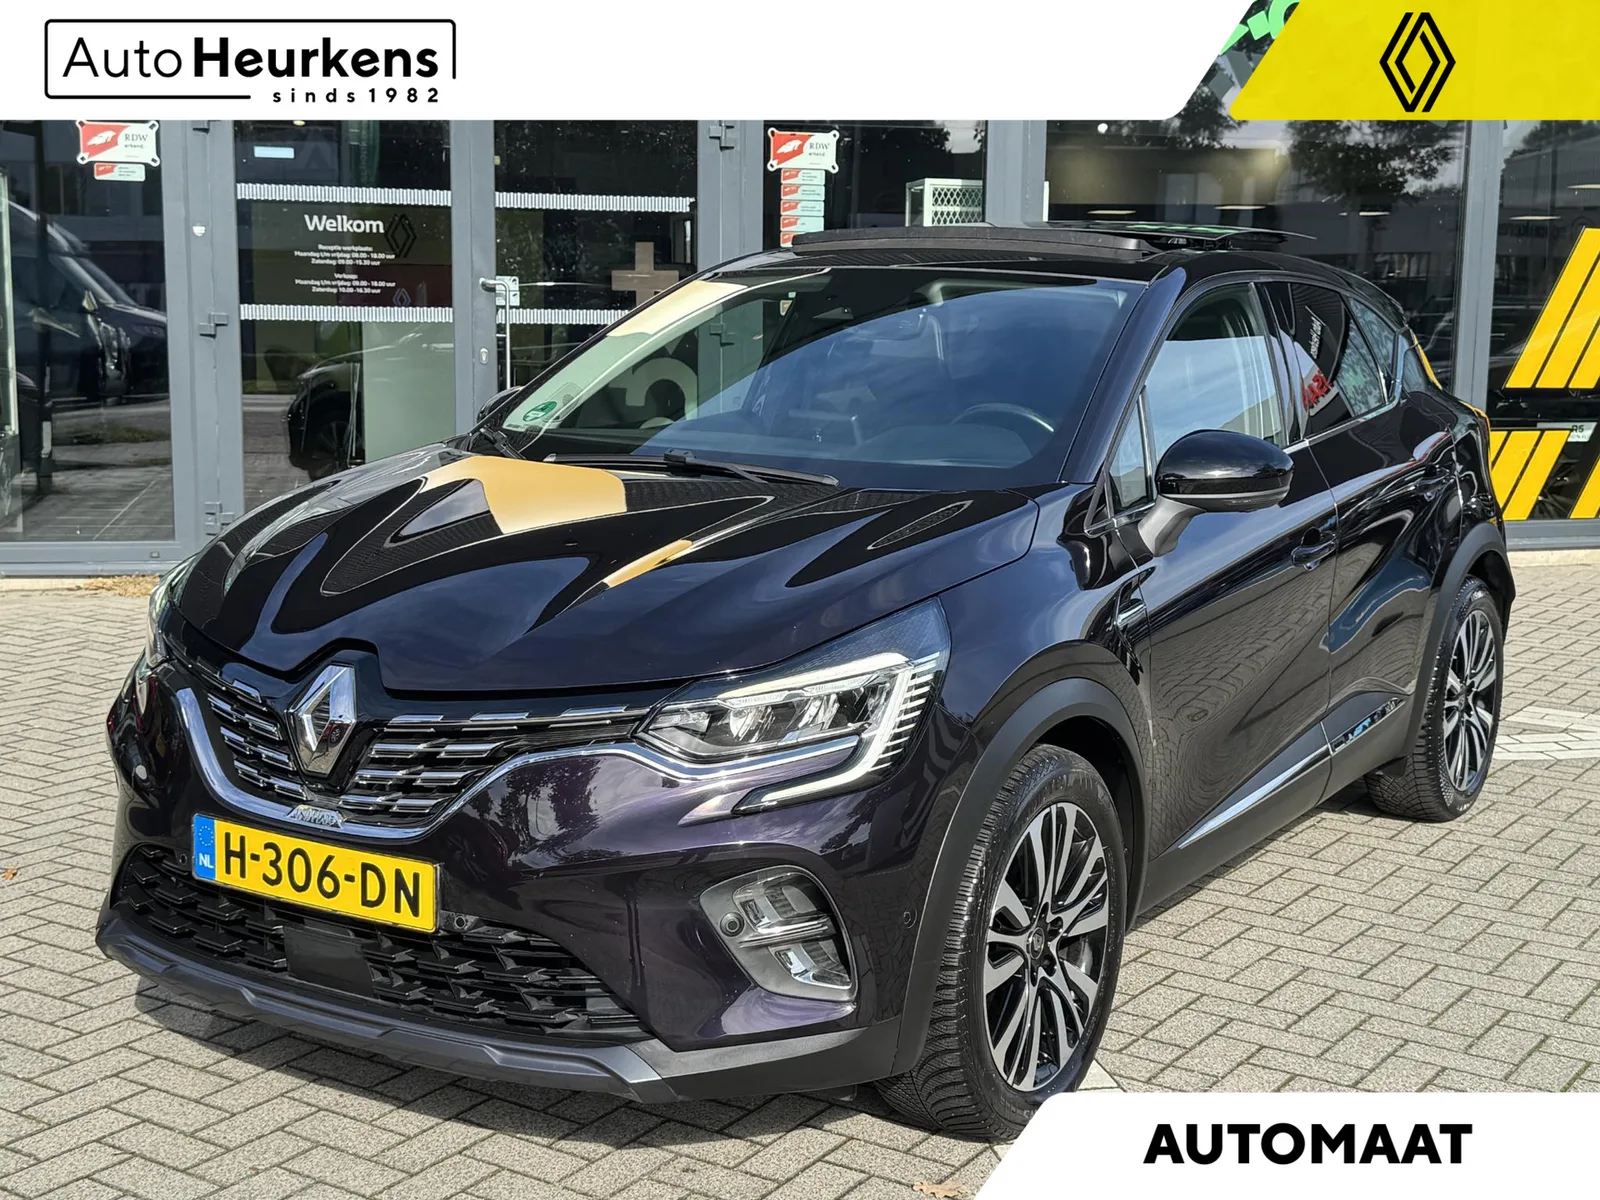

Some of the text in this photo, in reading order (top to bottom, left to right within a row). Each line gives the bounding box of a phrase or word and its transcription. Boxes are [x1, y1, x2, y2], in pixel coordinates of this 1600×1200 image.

[125, 133, 148, 141] RDW
[809, 142, 831, 150] RDW
[304, 214, 385, 233] Welkom
[198, 852, 215, 869] NL
[223, 831, 421, 918] H-306-DN
